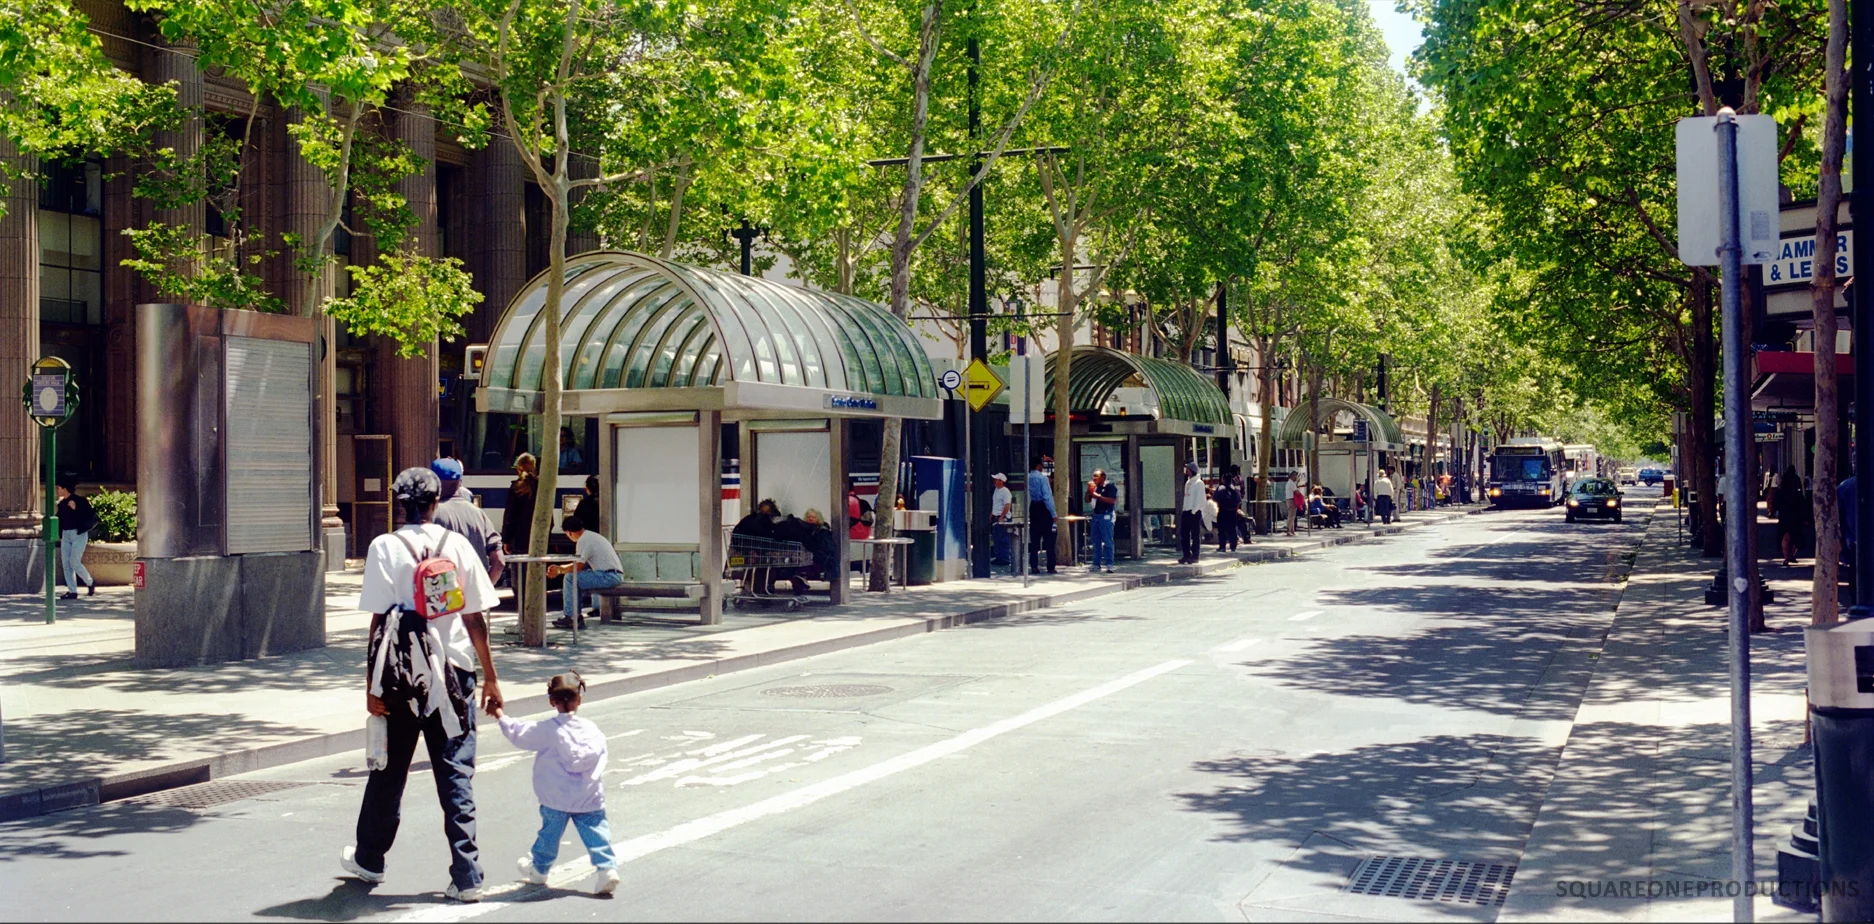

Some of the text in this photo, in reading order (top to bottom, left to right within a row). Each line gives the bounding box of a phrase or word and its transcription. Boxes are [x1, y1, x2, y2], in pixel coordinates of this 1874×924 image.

[1777, 235, 1848, 260] AMR
[1770, 264, 1782, 282] &
[1789, 256, 1848, 279] LES
